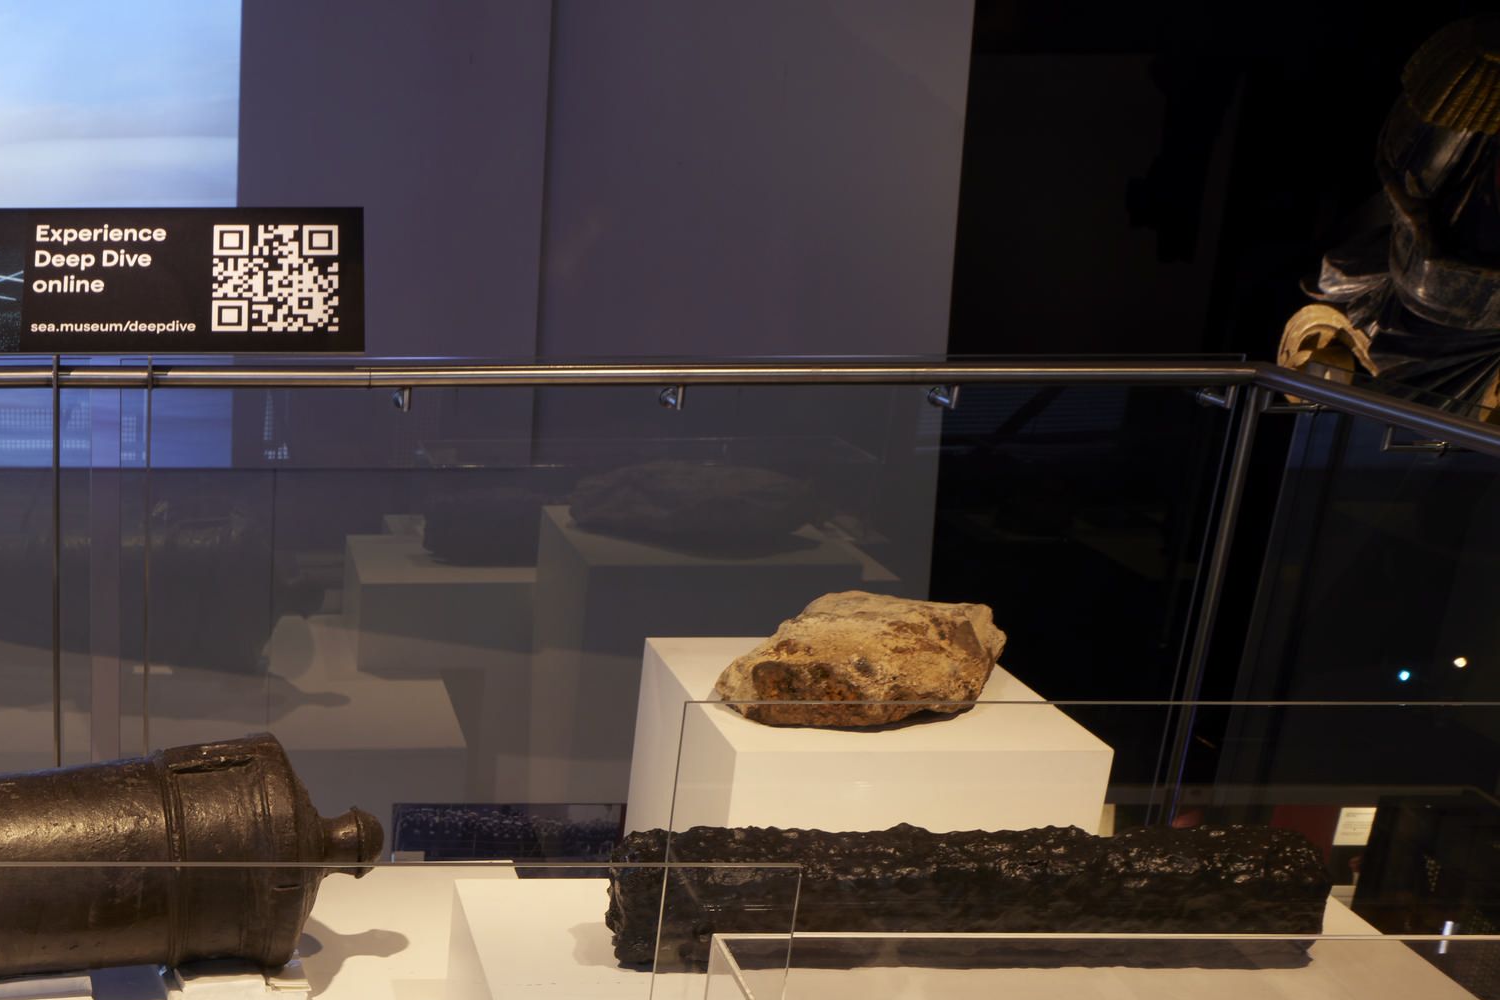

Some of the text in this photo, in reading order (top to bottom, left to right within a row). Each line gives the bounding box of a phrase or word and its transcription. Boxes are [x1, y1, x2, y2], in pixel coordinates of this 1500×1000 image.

[36, 224, 166, 246] Experience
[34, 249, 152, 271] Deep Dive
[32, 275, 104, 293] online
[30, 320, 196, 334] sea.museum/deepdive
